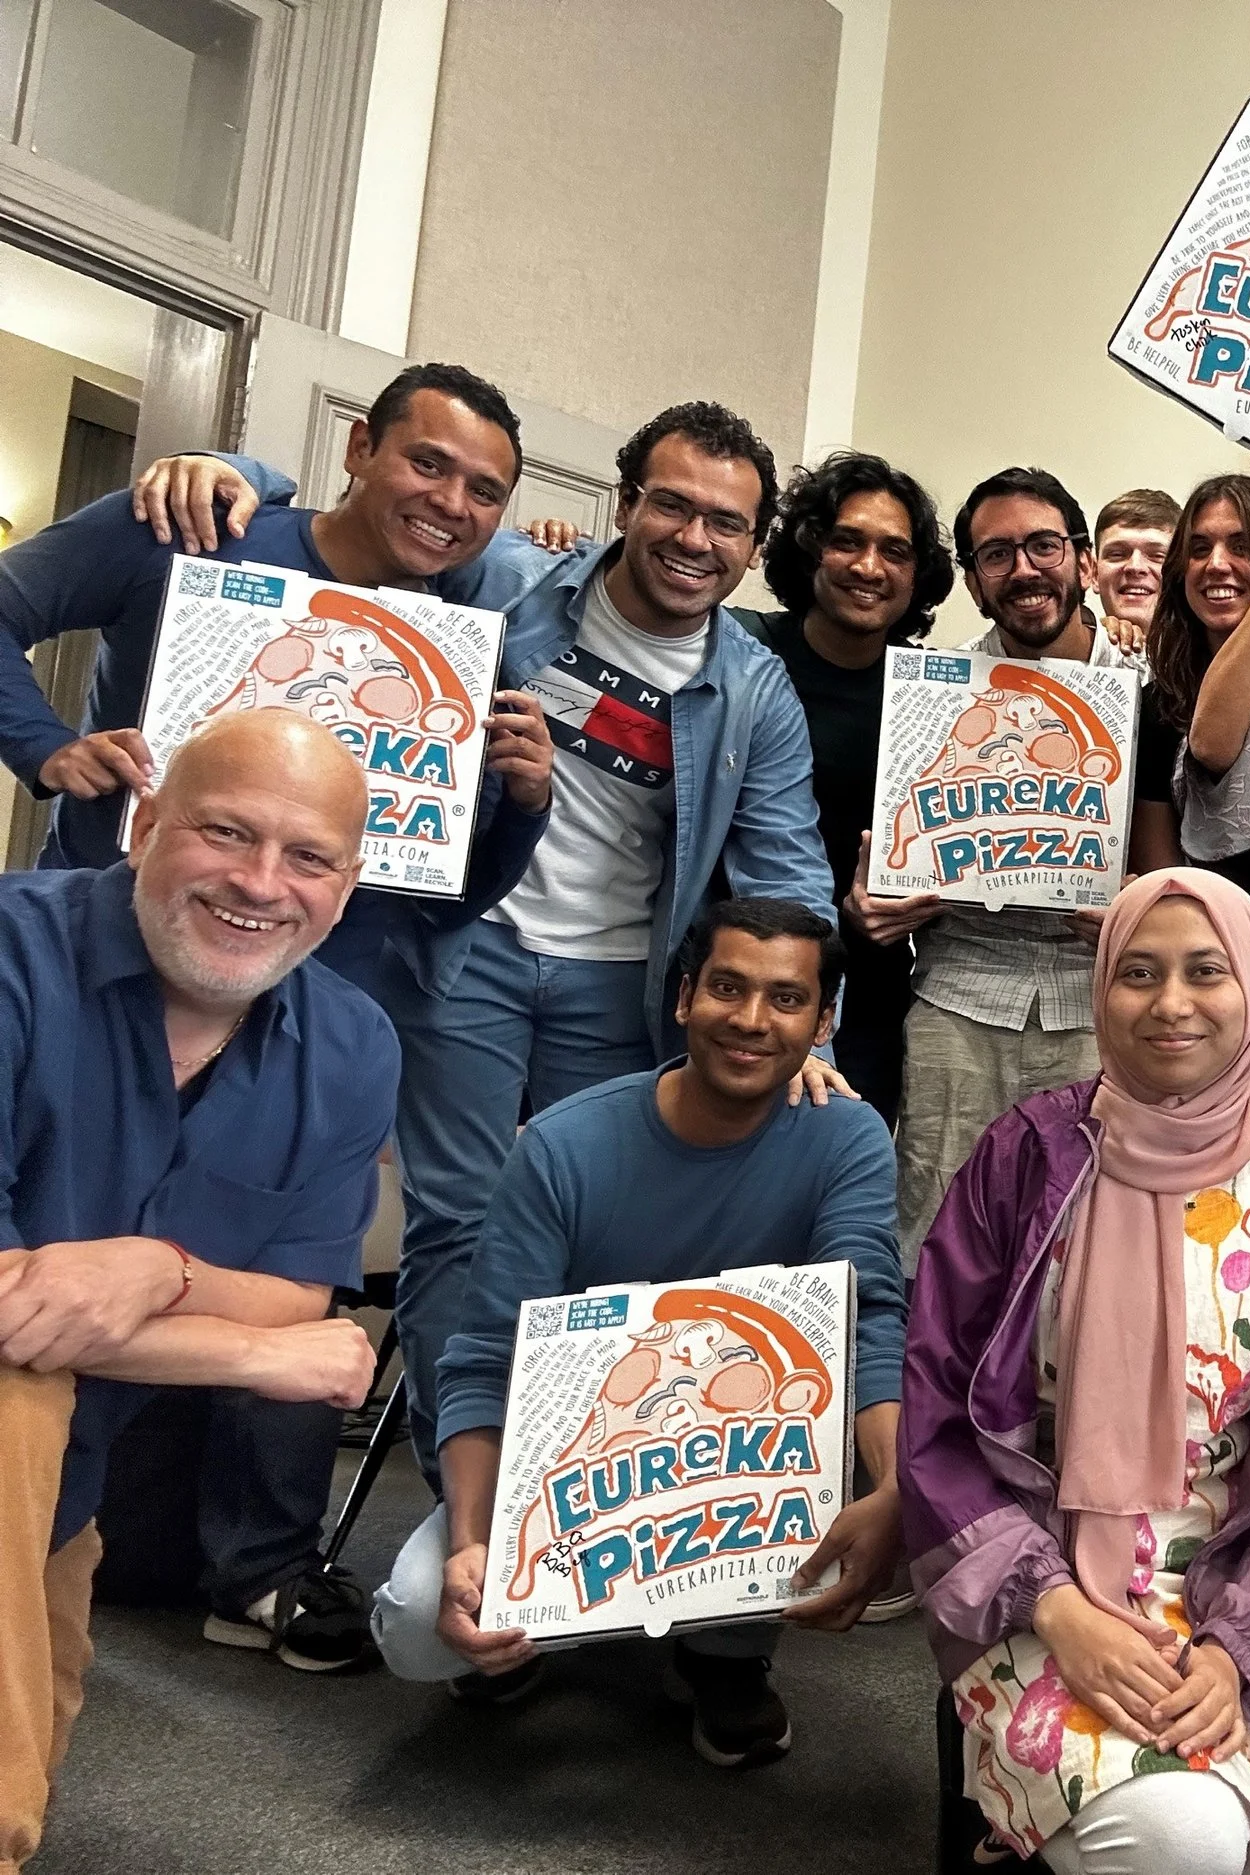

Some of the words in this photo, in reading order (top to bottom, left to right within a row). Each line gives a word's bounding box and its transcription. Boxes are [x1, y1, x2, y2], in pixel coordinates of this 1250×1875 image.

[1144, 302, 1160, 318] GIVE
[1223, 233, 1236, 248] YOU
[1127, 336, 1142, 354] BE
[173, 601, 203, 626] FORGET
[373, 597, 391, 608] MAKE
[392, 606, 409, 618] EACH
[409, 615, 423, 628] DAY
[424, 627, 443, 642] YOUR
[415, 604, 435, 622] LIVE
[436, 619, 456, 638] WITH
[446, 610, 465, 626] BE
[1069, 669, 1085, 684] LIVE
[1086, 680, 1102, 696] WITH
[1093, 671, 1108, 685] BE
[1077, 686, 1092, 702] YOUR
[880, 874, 891, 886] BE
[986, 873, 1093, 890] EUREKAPIZZA.COM
[715, 1282, 734, 1292] MAKE
[735, 1286, 752, 1297] EACH
[752, 1291, 768, 1303] DAY
[769, 1298, 789, 1314] YOUR
[758, 1276, 780, 1293] LIVE
[780, 1284, 802, 1304] WITH
[790, 1272, 809, 1289] BE
[805, 1276, 840, 1313] BRAVE.
[521, 1342, 550, 1373] FORGET
[597, 1353, 618, 1374] SMILE
[578, 1378, 601, 1413] CHEERFUL
[511, 1480, 526, 1502] TRUE
[521, 1468, 533, 1480] TO
[529, 1431, 553, 1466] YOURSELF
[552, 1415, 568, 1431] AND
[565, 1392, 579, 1413] YOUR
[574, 1370, 590, 1391] PEACE
[587, 1357, 596, 1367] OF
[597, 1340, 616, 1357] MIND
[561, 1423, 577, 1443] MEET
[549, 1445, 563, 1460] YOU
[525, 1462, 551, 1501] CREATURE
[508, 1503, 530, 1530] LIVING
[505, 1531, 518, 1560] EVERY
[500, 1561, 515, 1583] GIVE
[648, 1554, 800, 1605] EUREKAPIZZA.COM
[496, 1611, 511, 1629] BE
[518, 1605, 571, 1624] HELPFUL.
